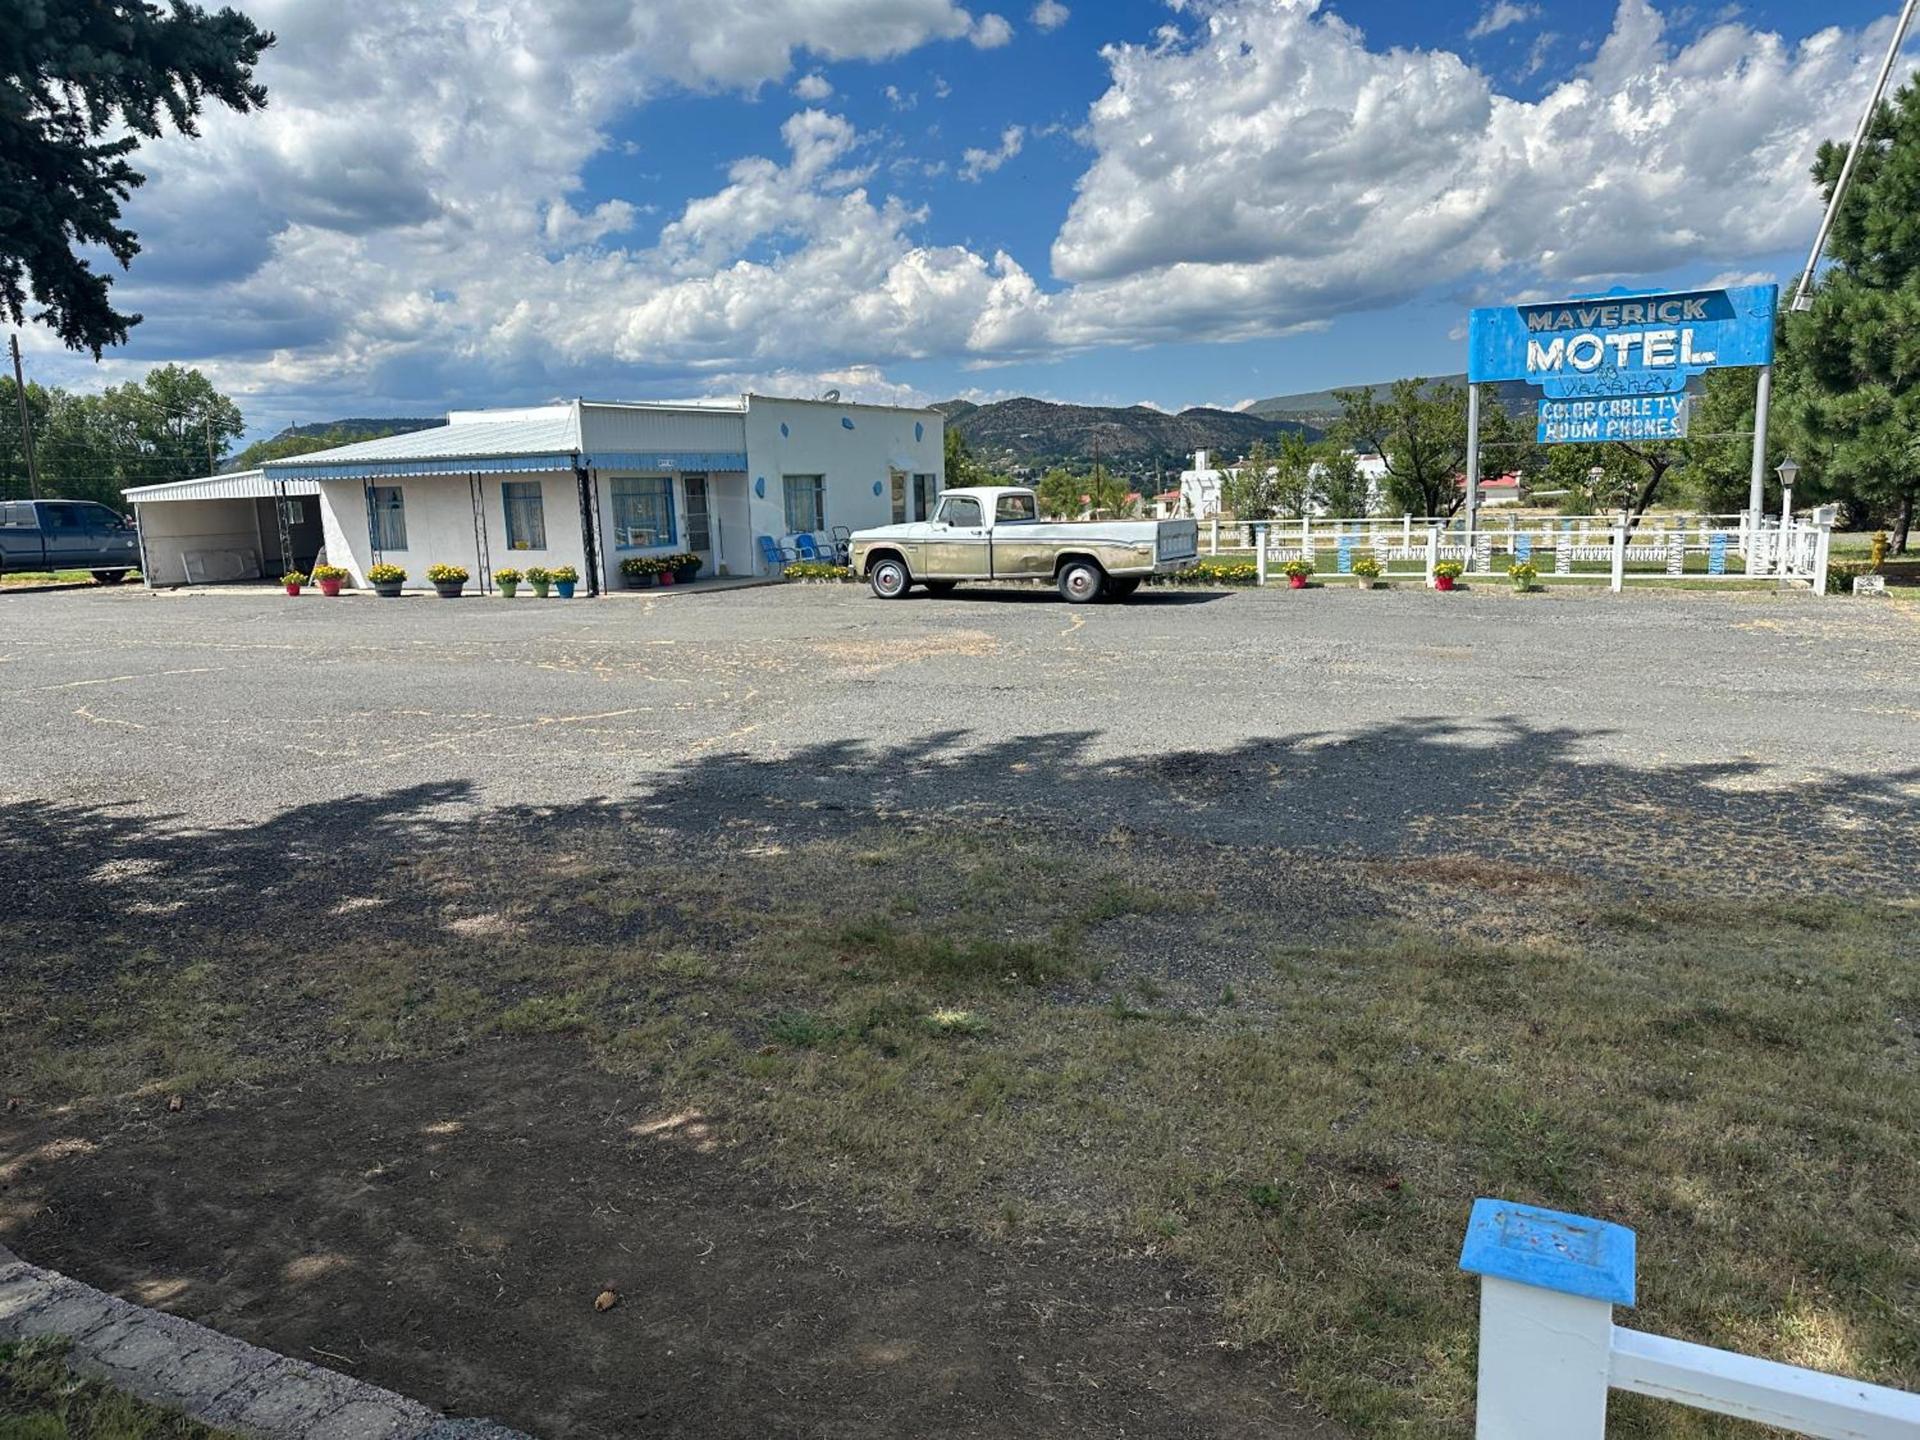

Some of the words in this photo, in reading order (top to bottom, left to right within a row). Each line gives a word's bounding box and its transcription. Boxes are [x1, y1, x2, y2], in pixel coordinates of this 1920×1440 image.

[1528, 298, 1709, 331] MAVERICK
[1526, 328, 1716, 373] MOTEL
[1542, 401, 1596, 419] COLOR
[1598, 398, 1651, 417] CABLE
[1546, 420, 1598, 439] ROOM
[1606, 416, 1681, 437] PHONES
